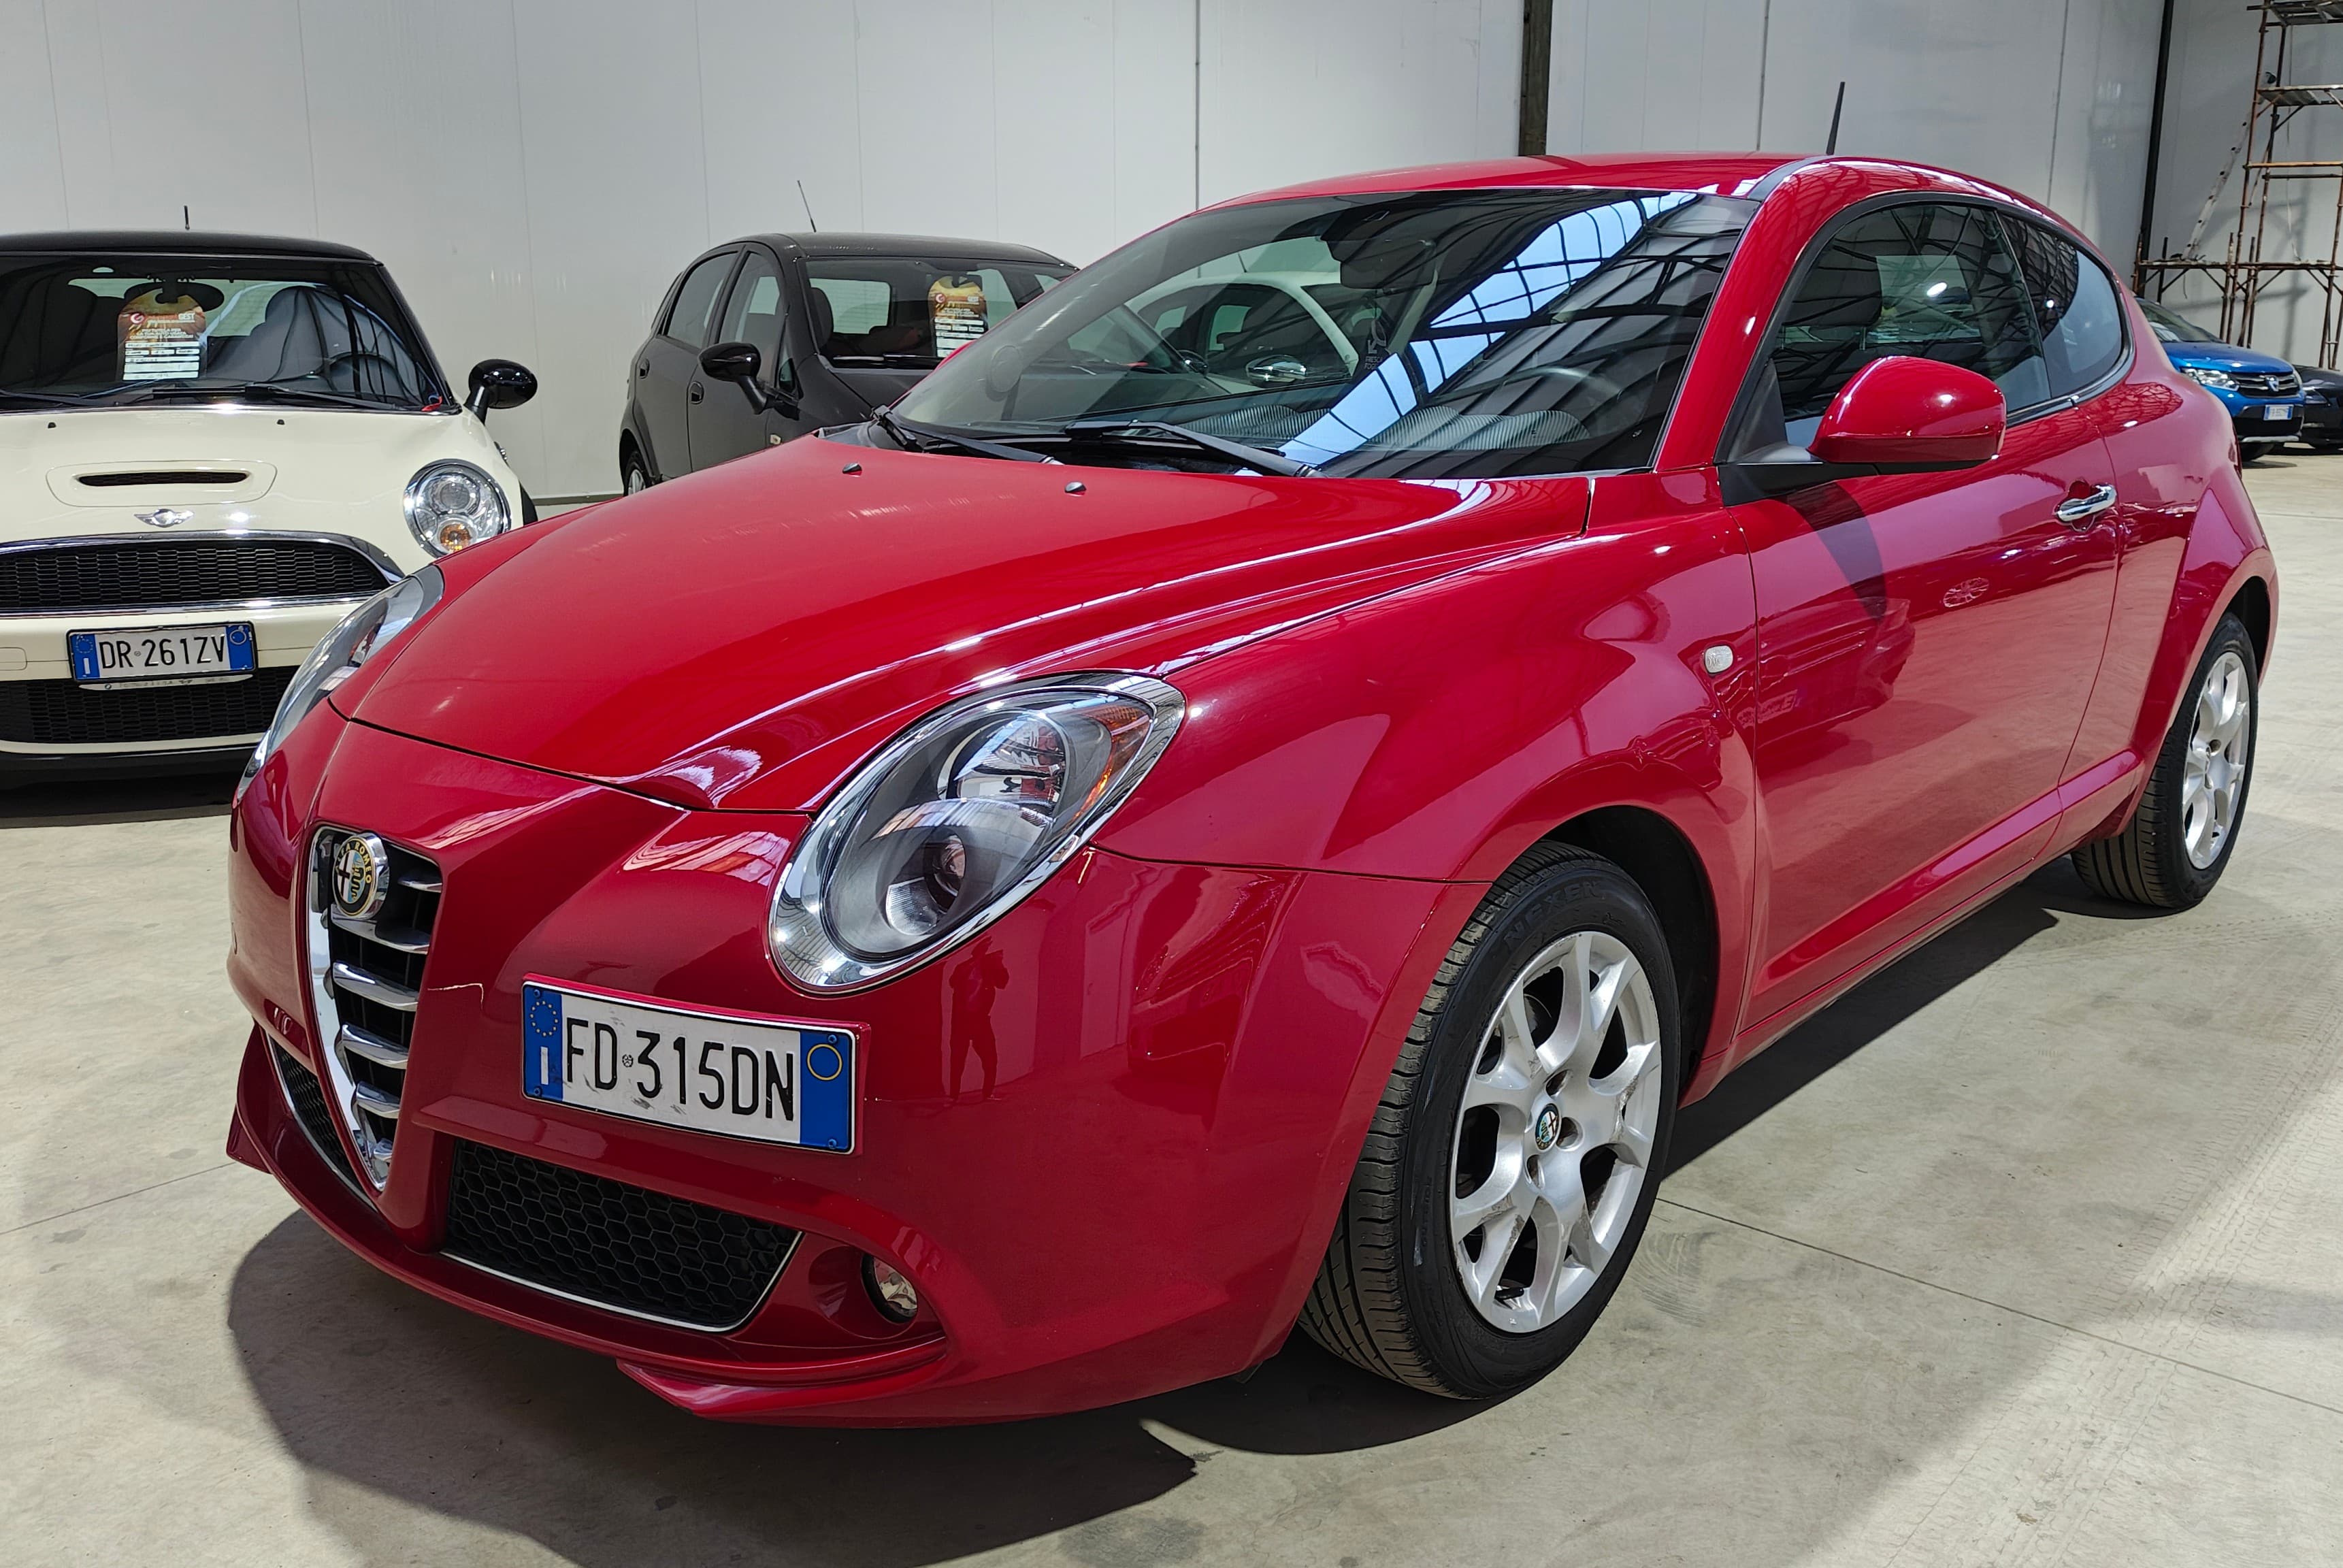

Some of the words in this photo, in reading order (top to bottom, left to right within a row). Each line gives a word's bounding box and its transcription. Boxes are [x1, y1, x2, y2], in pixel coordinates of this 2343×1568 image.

[99, 640, 133, 669] DR
[141, 633, 225, 666] 261ZV
[355, 841, 372, 884] ROMEO
[567, 1017, 618, 1090] FD
[636, 1030, 794, 1122] 315DN
